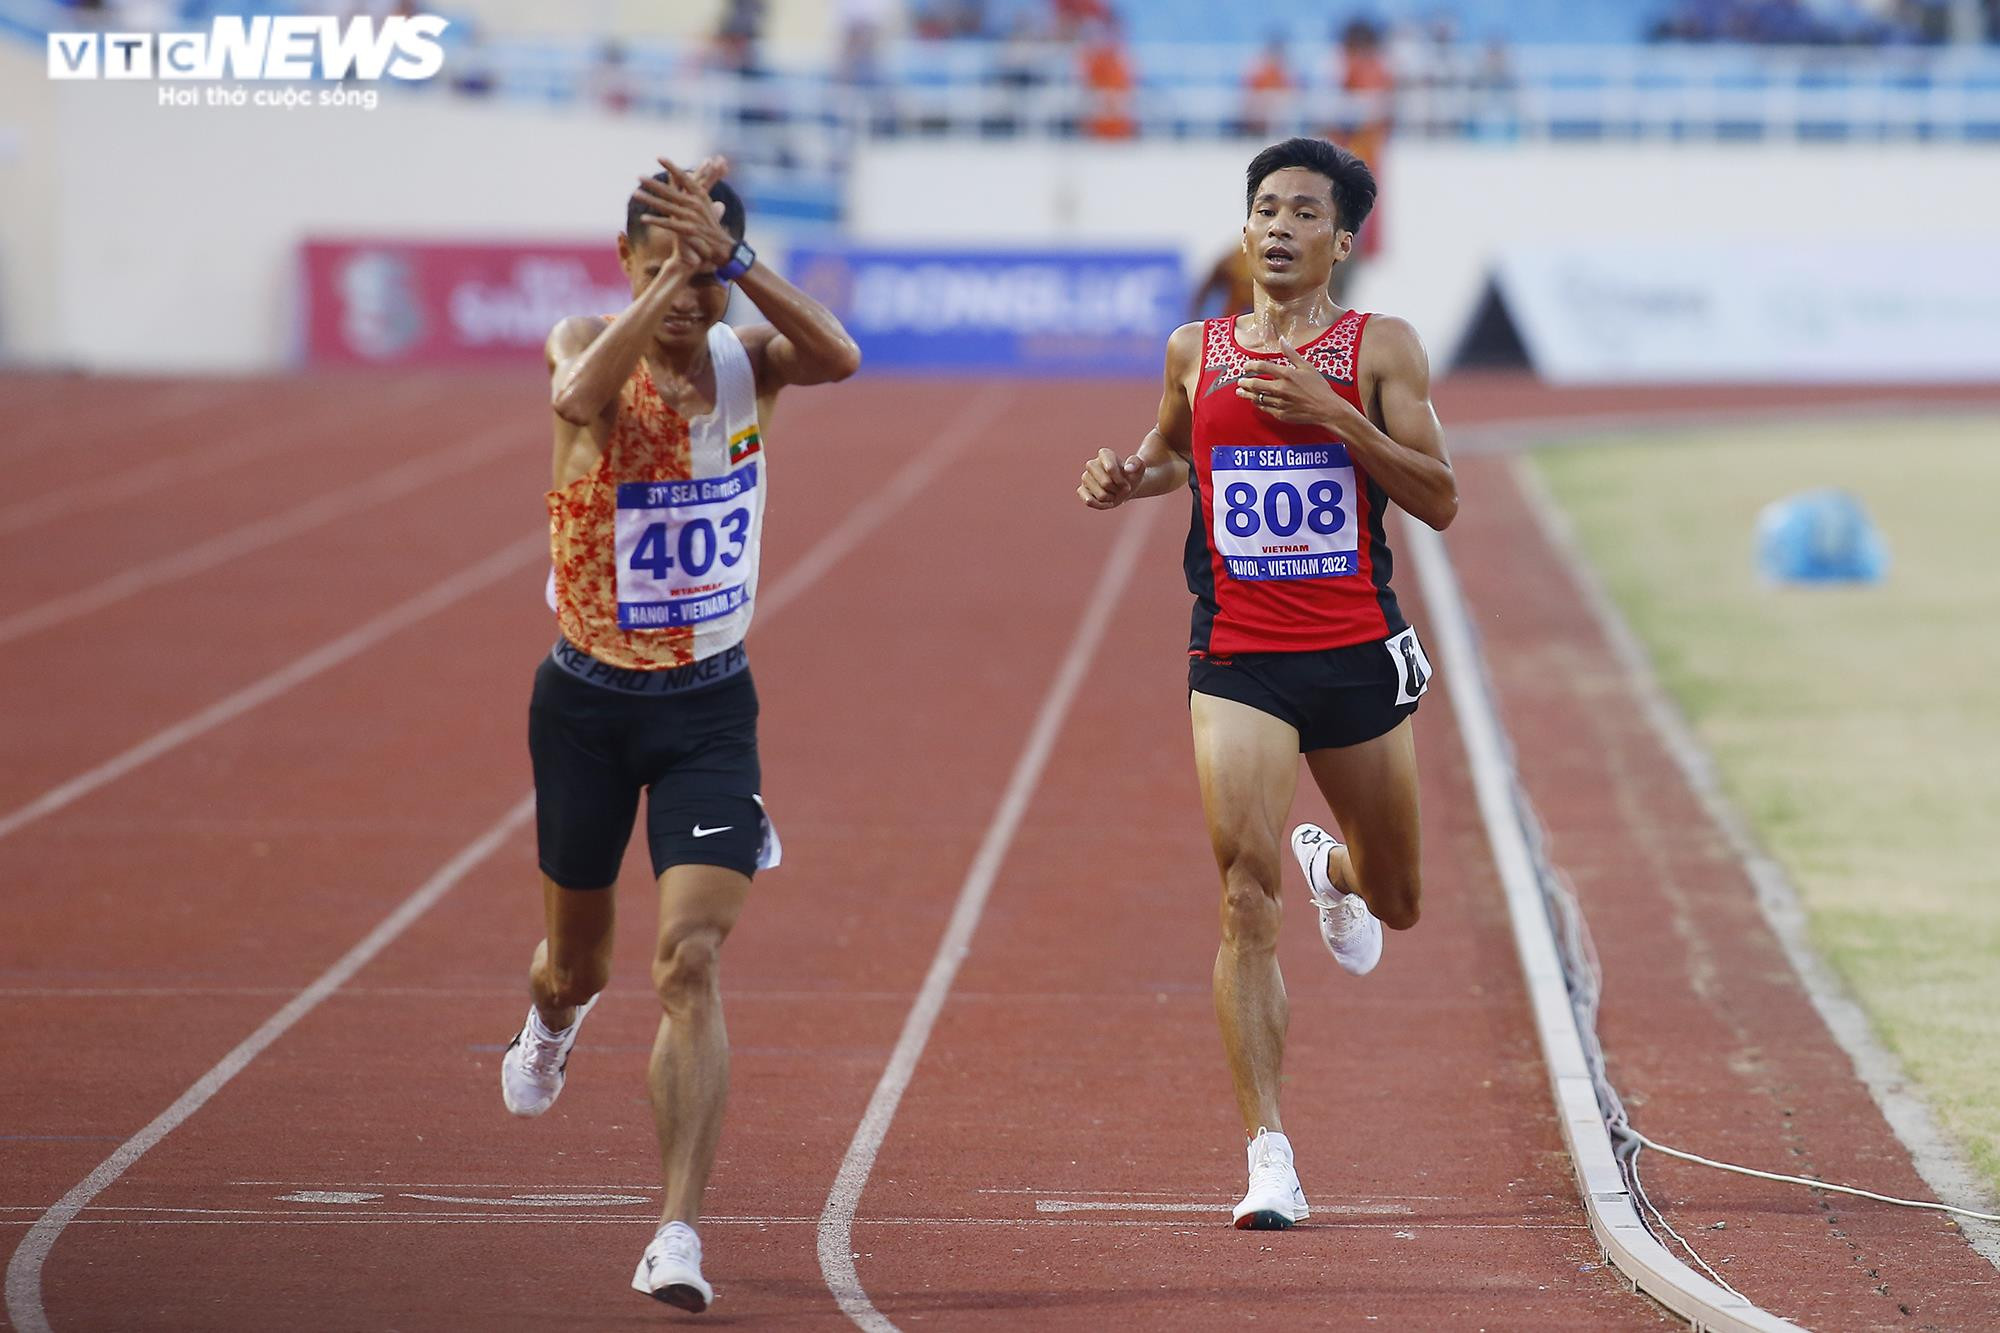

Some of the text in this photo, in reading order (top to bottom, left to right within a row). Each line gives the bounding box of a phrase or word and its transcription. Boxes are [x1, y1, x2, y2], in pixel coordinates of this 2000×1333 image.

[1258, 449, 1283, 467] SEA
[1286, 449, 1329, 466] Games
[670, 483, 699, 504] SEA
[702, 477, 741, 500] Games
[1224, 480, 1346, 538] 808
[629, 507, 750, 580] 403
[1261, 544, 1310, 554] VIETNAM
[1267, 558, 1319, 577] VIETNAM
[1321, 556, 1348, 574] 2022
[628, 605, 670, 625] HANOI
[680, 593, 729, 621] VIETNAM
[586, 660, 653, 692] PRO
[661, 655, 719, 692] NIKE
